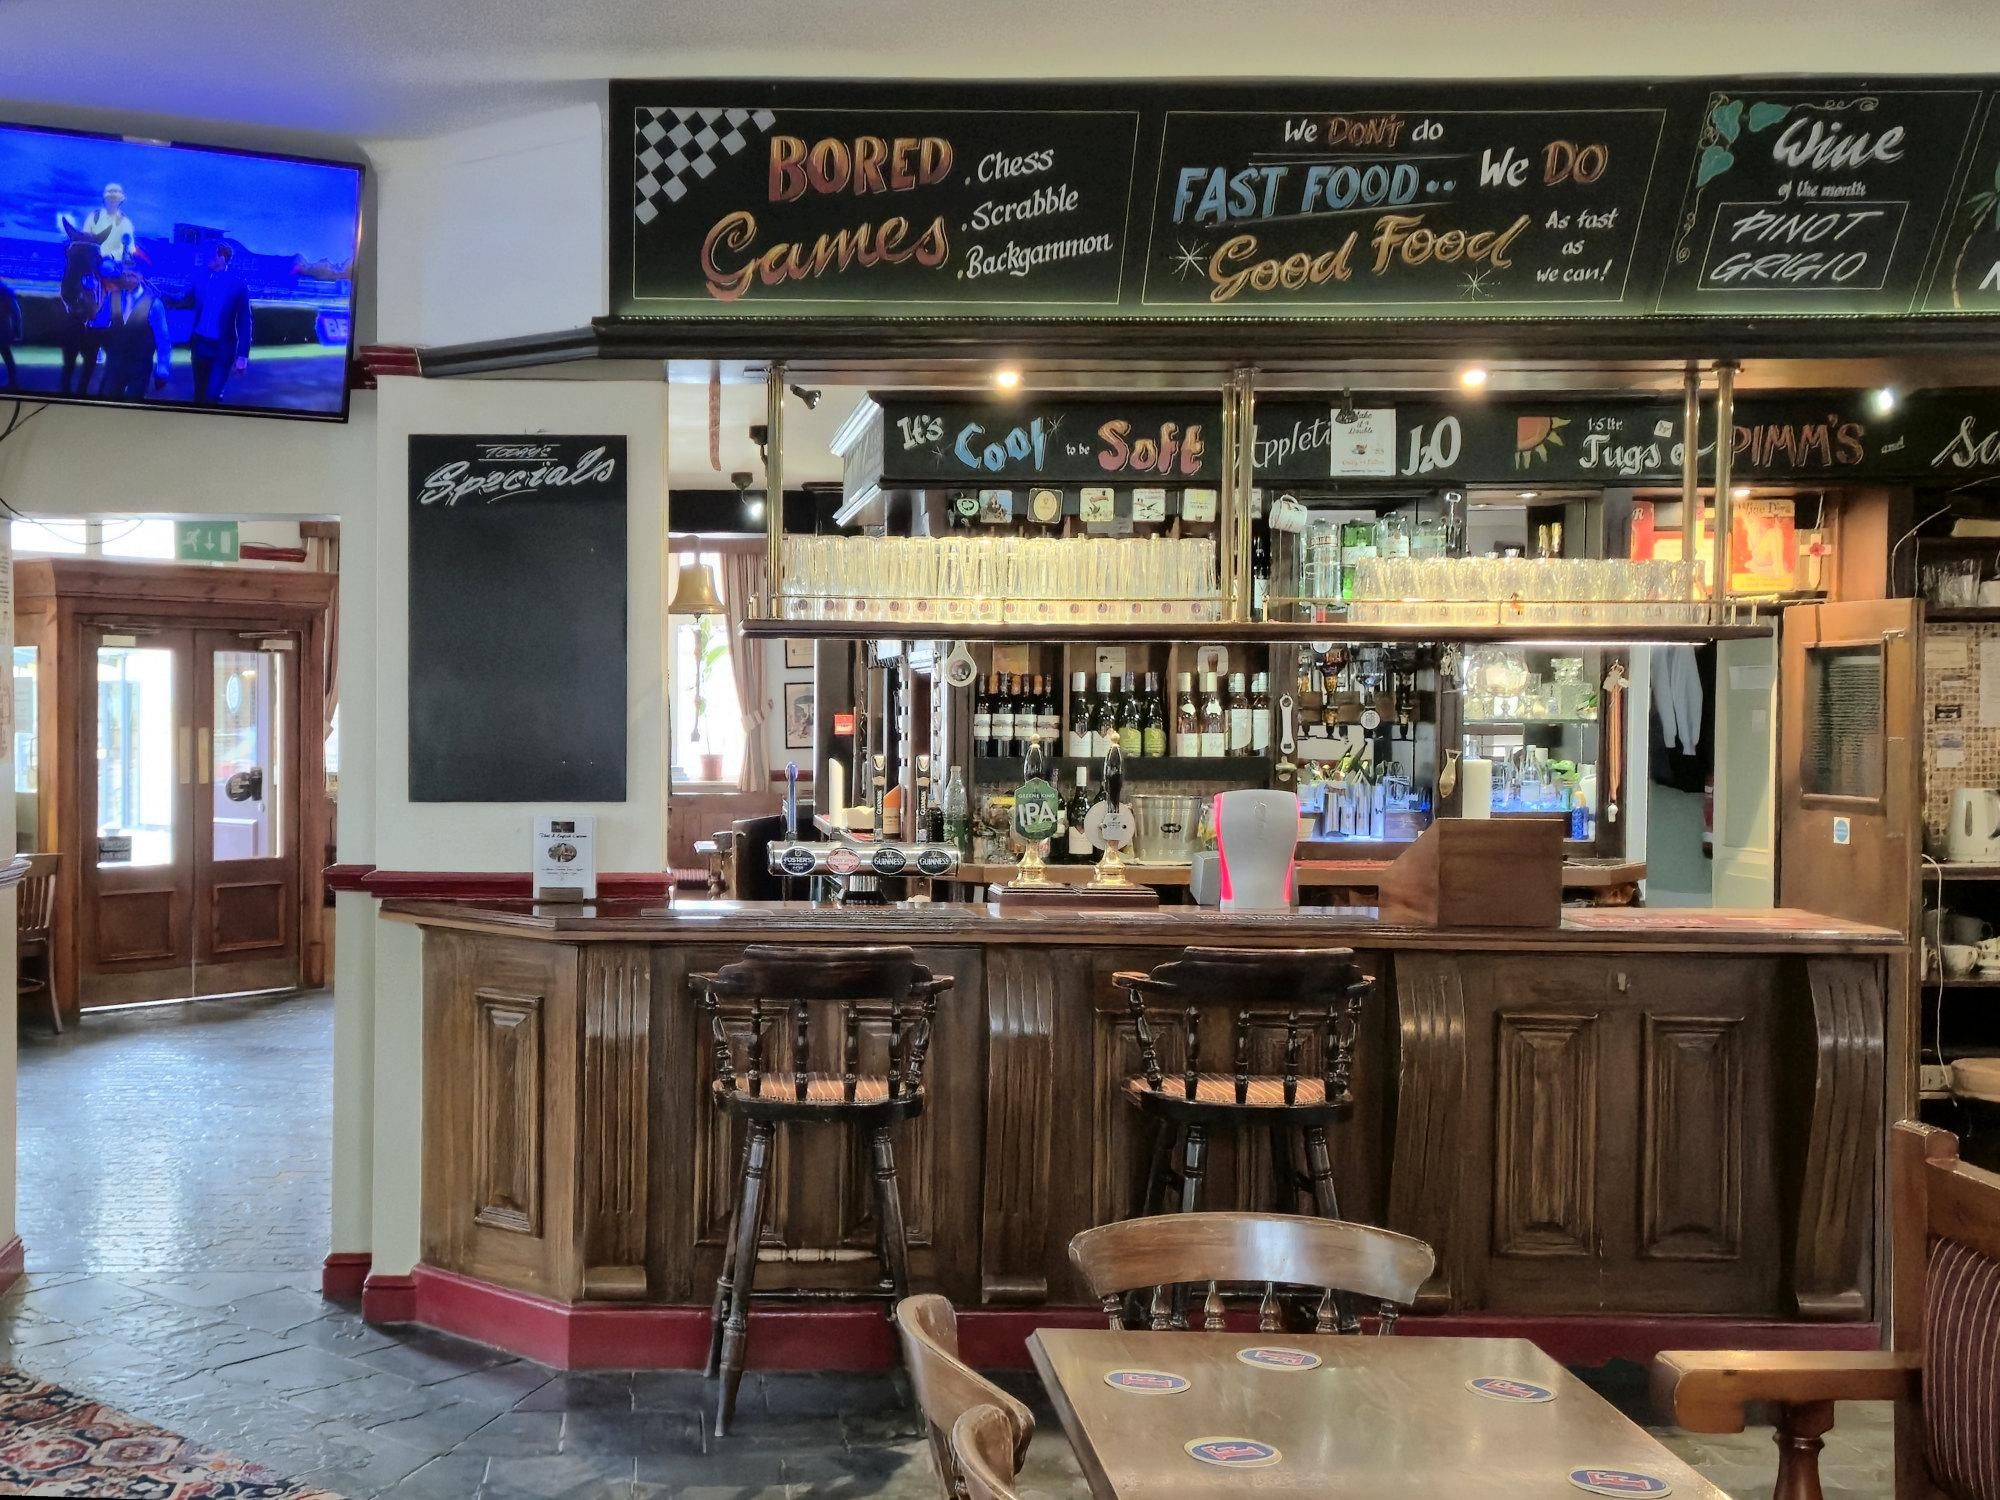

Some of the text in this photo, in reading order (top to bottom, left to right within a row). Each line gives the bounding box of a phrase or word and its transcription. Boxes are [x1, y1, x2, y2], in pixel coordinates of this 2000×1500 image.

[1285, 119, 1318, 143] We
[1412, 119, 1444, 141] do
[1772, 117, 1906, 171] Wine
[768, 135, 953, 201] BORED
[977, 148, 1055, 184] Chess
[1173, 165, 1289, 224] FAST
[1480, 149, 1529, 188] We
[1542, 140, 1608, 186] DO
[971, 184, 1079, 231] Scrabble
[1778, 180, 1867, 202] of the month
[1545, 210, 1619, 230] As fast
[1731, 209, 1885, 243] PINOT
[701, 210, 952, 301] Games
[967, 232, 1113, 278] Backgammon
[1208, 214, 1532, 302] Good Food
[1562, 240, 1584, 255] as
[1536, 260, 1610, 282] we can!
[1710, 252, 1868, 282] GRIGIO
[897, 414, 1206, 475] It's Cool to be Soft
[1579, 434, 1661, 475] Jugs
[1730, 414, 1864, 468] PIMM'S
[417, 446, 615, 506] Specials
[1018, 800, 1056, 828] IPA
[874, 857, 905, 866] GUINNESS
[919, 857, 949, 866] GUINNESS
